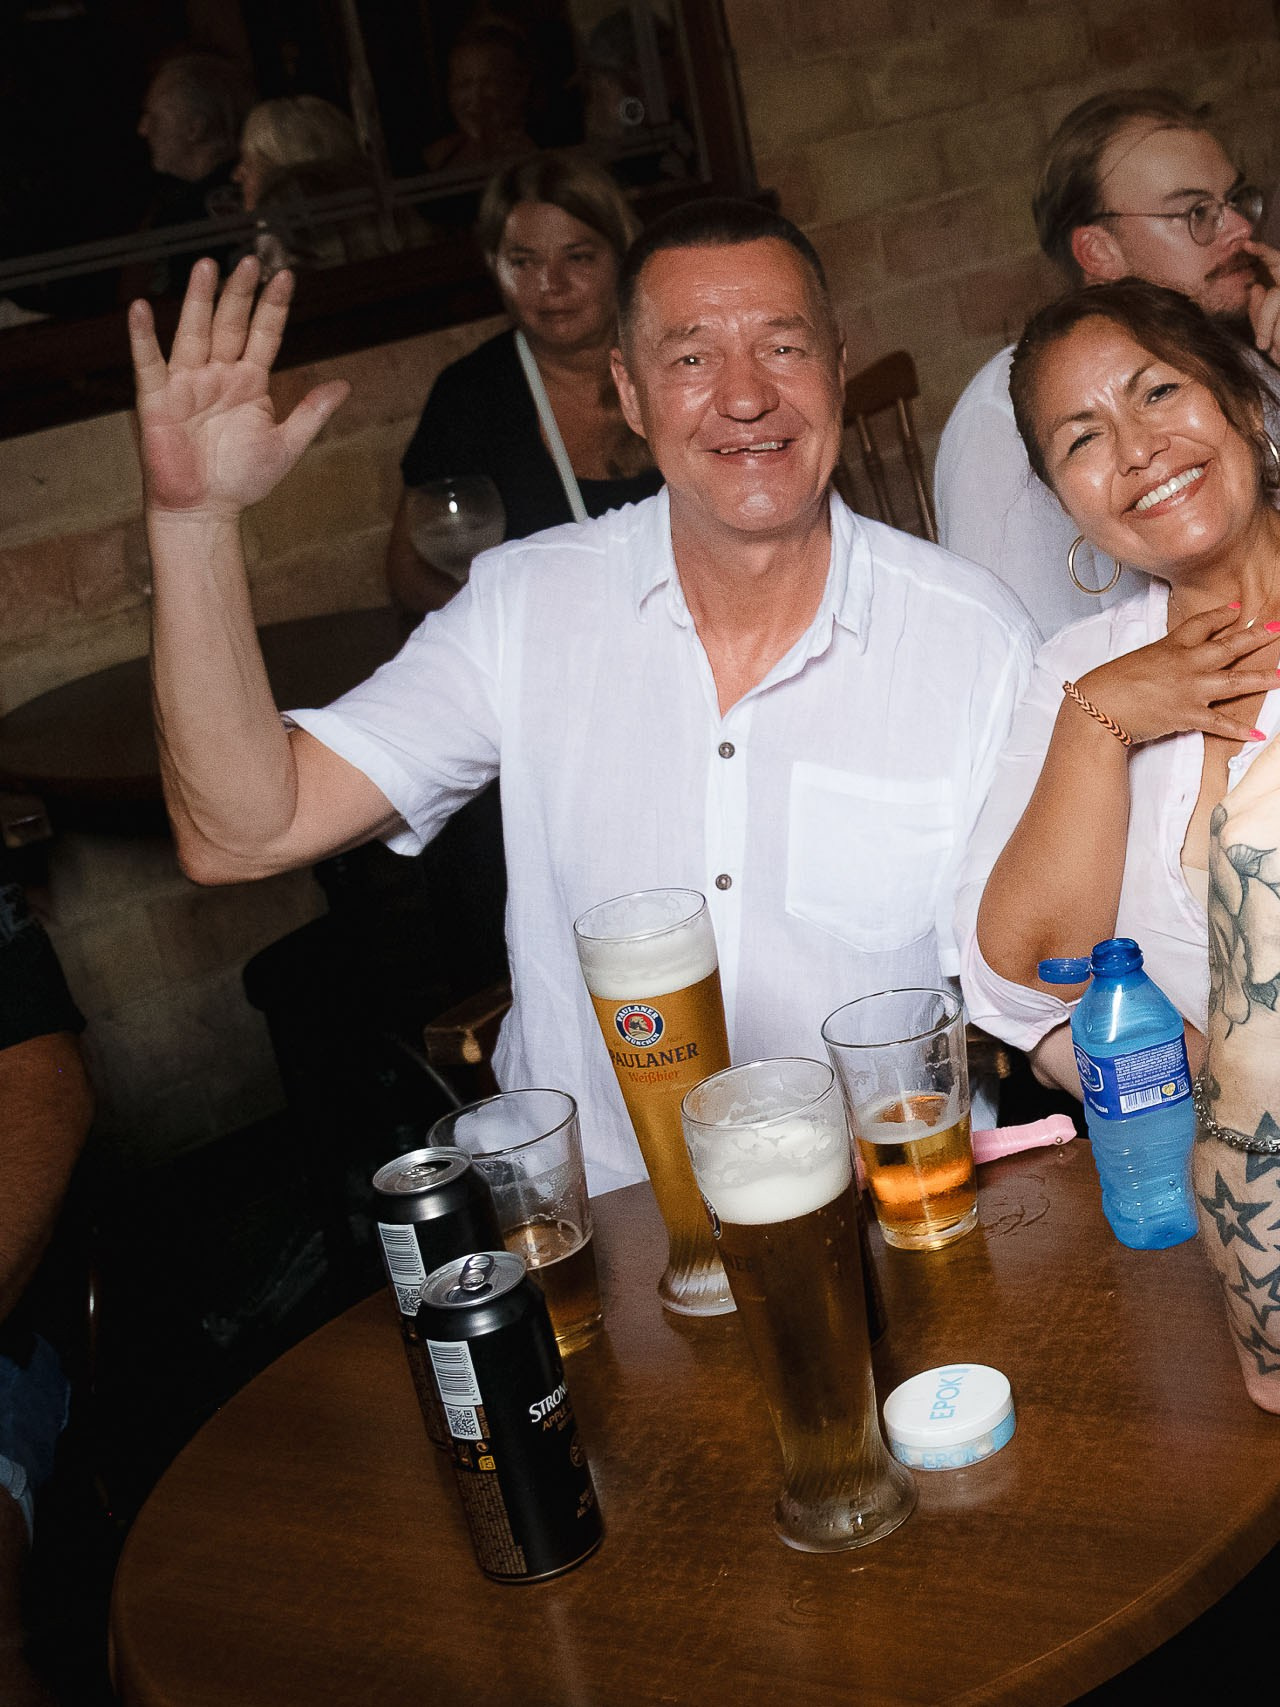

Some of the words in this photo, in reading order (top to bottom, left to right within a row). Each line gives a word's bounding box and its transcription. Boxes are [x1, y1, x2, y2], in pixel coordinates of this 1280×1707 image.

[616, 1005, 659, 1022] PAULANER
[628, 1070, 681, 1085] Weißbier
[529, 1381, 568, 1423] STRON
